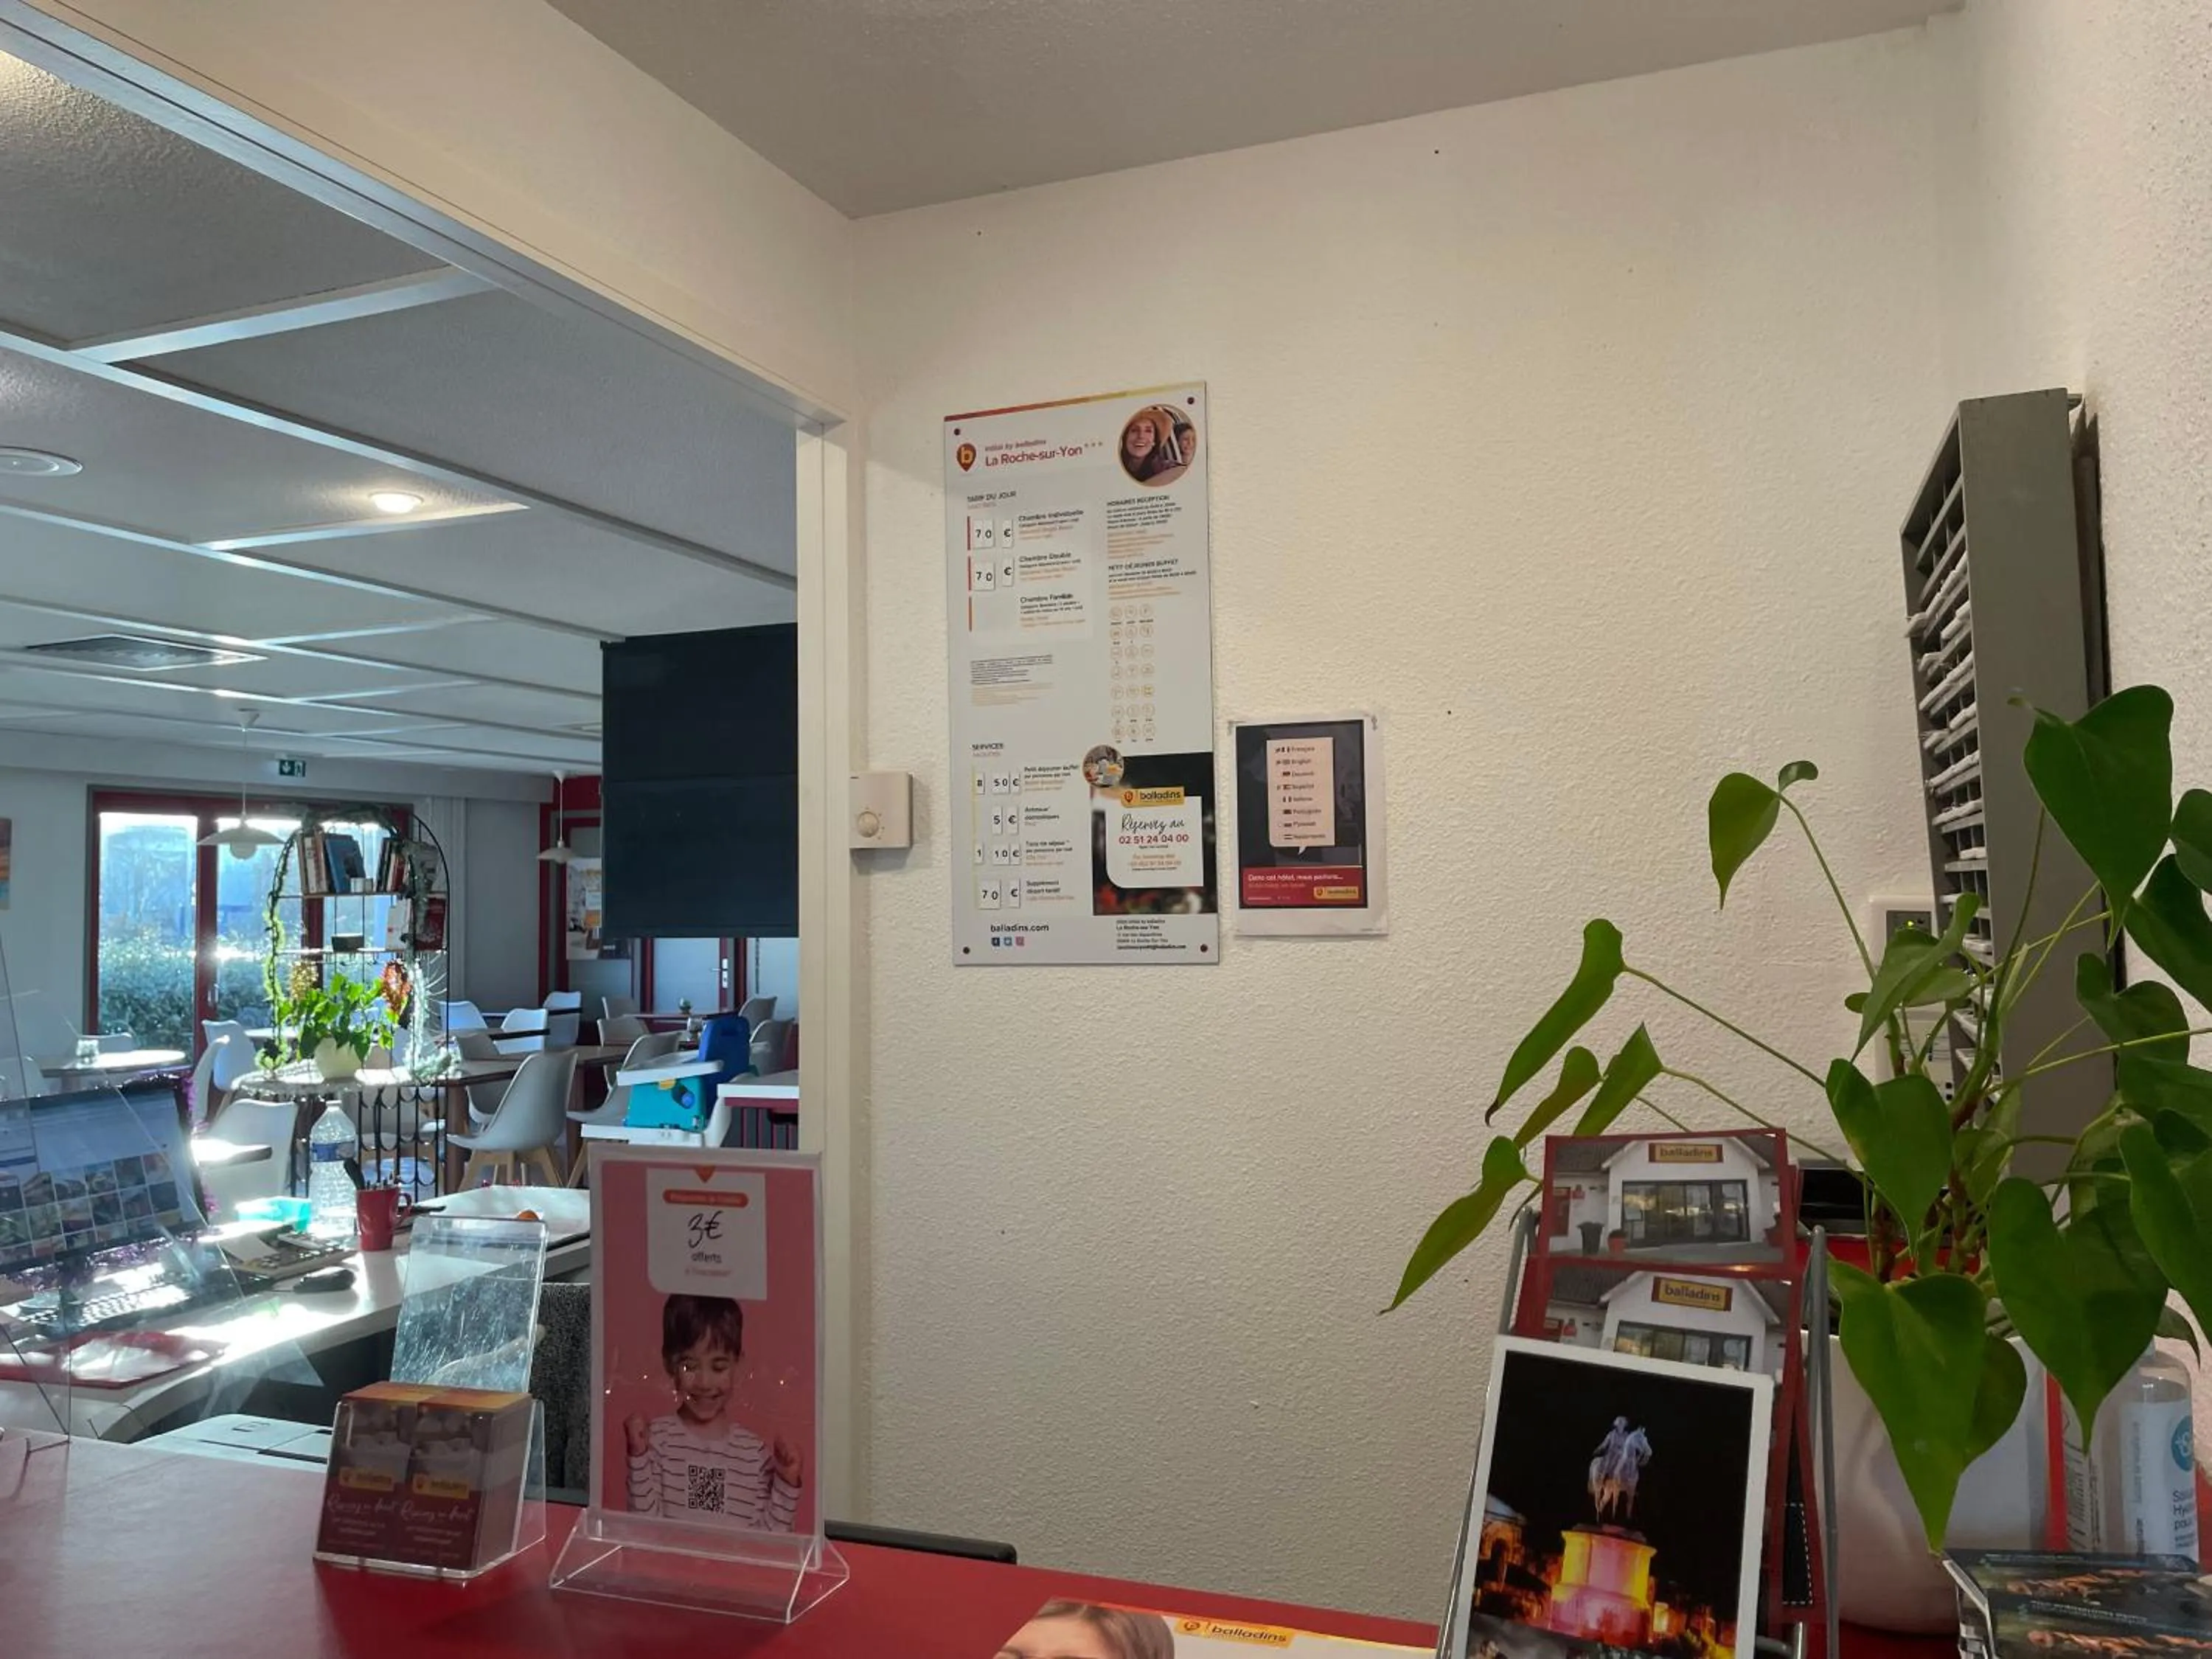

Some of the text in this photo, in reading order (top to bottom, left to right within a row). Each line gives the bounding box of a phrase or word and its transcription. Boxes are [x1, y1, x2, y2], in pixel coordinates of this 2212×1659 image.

[985, 445, 1083, 467] La Roche-sur-Yon
[986, 493, 996, 501] DU
[998, 490, 1017, 499] JOUR
[1019, 554, 1047, 563] Chambre
[1140, 790, 1180, 800] balladins
[993, 815, 1001, 825] 5
[1008, 815, 1017, 824] €
[1119, 834, 1189, 844] 02 51 24 04 00
[1011, 888, 1018, 897] €
[990, 924, 1049, 932] balladins.com
[691, 1251, 722, 1264] offerts
[1211, 1624, 1287, 1642] balladins
